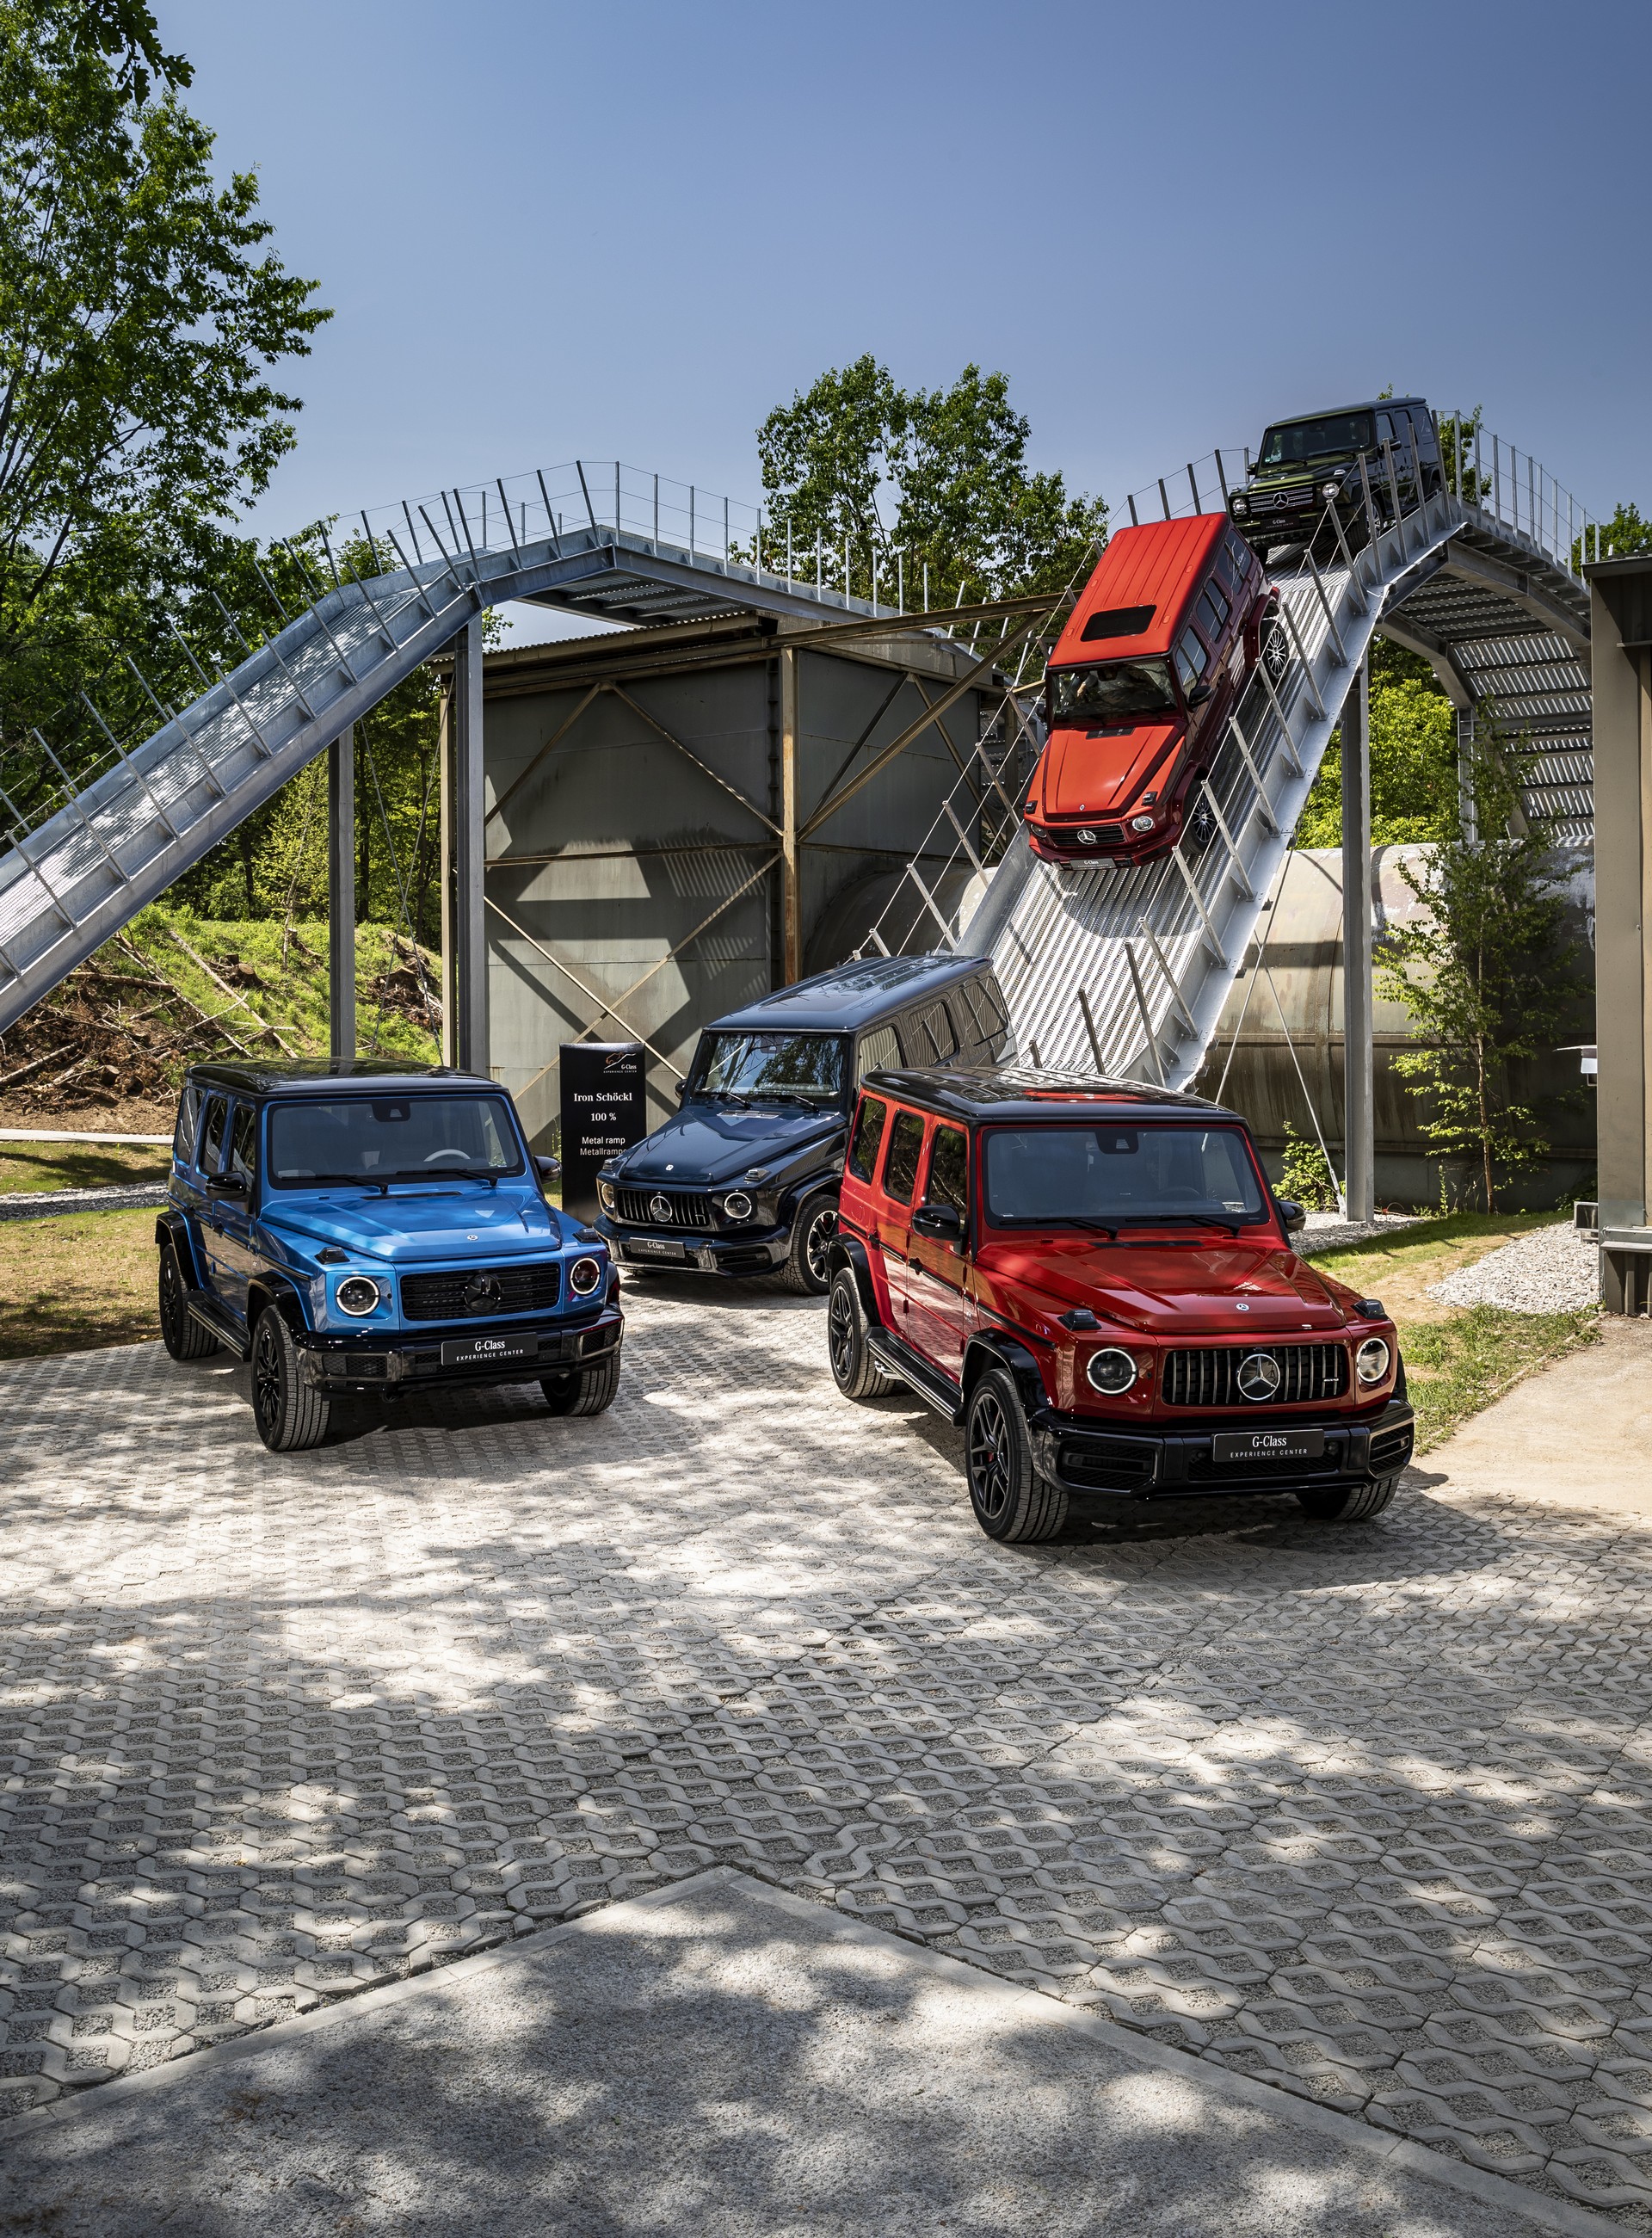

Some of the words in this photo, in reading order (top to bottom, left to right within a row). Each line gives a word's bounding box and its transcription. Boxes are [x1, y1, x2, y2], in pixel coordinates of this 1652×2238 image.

[574, 1093, 594, 1101] Iron
[596, 1093, 632, 1101] Schöckl
[591, 1113, 607, 1121] 100
[609, 1113, 617, 1121] %
[475, 1340, 506, 1352] G-Class
[456, 1352, 496, 1361] EXPERIENCE
[1252, 1435, 1287, 1447] G-Class
[1230, 1450, 1275, 1458] EXPERIENCE
